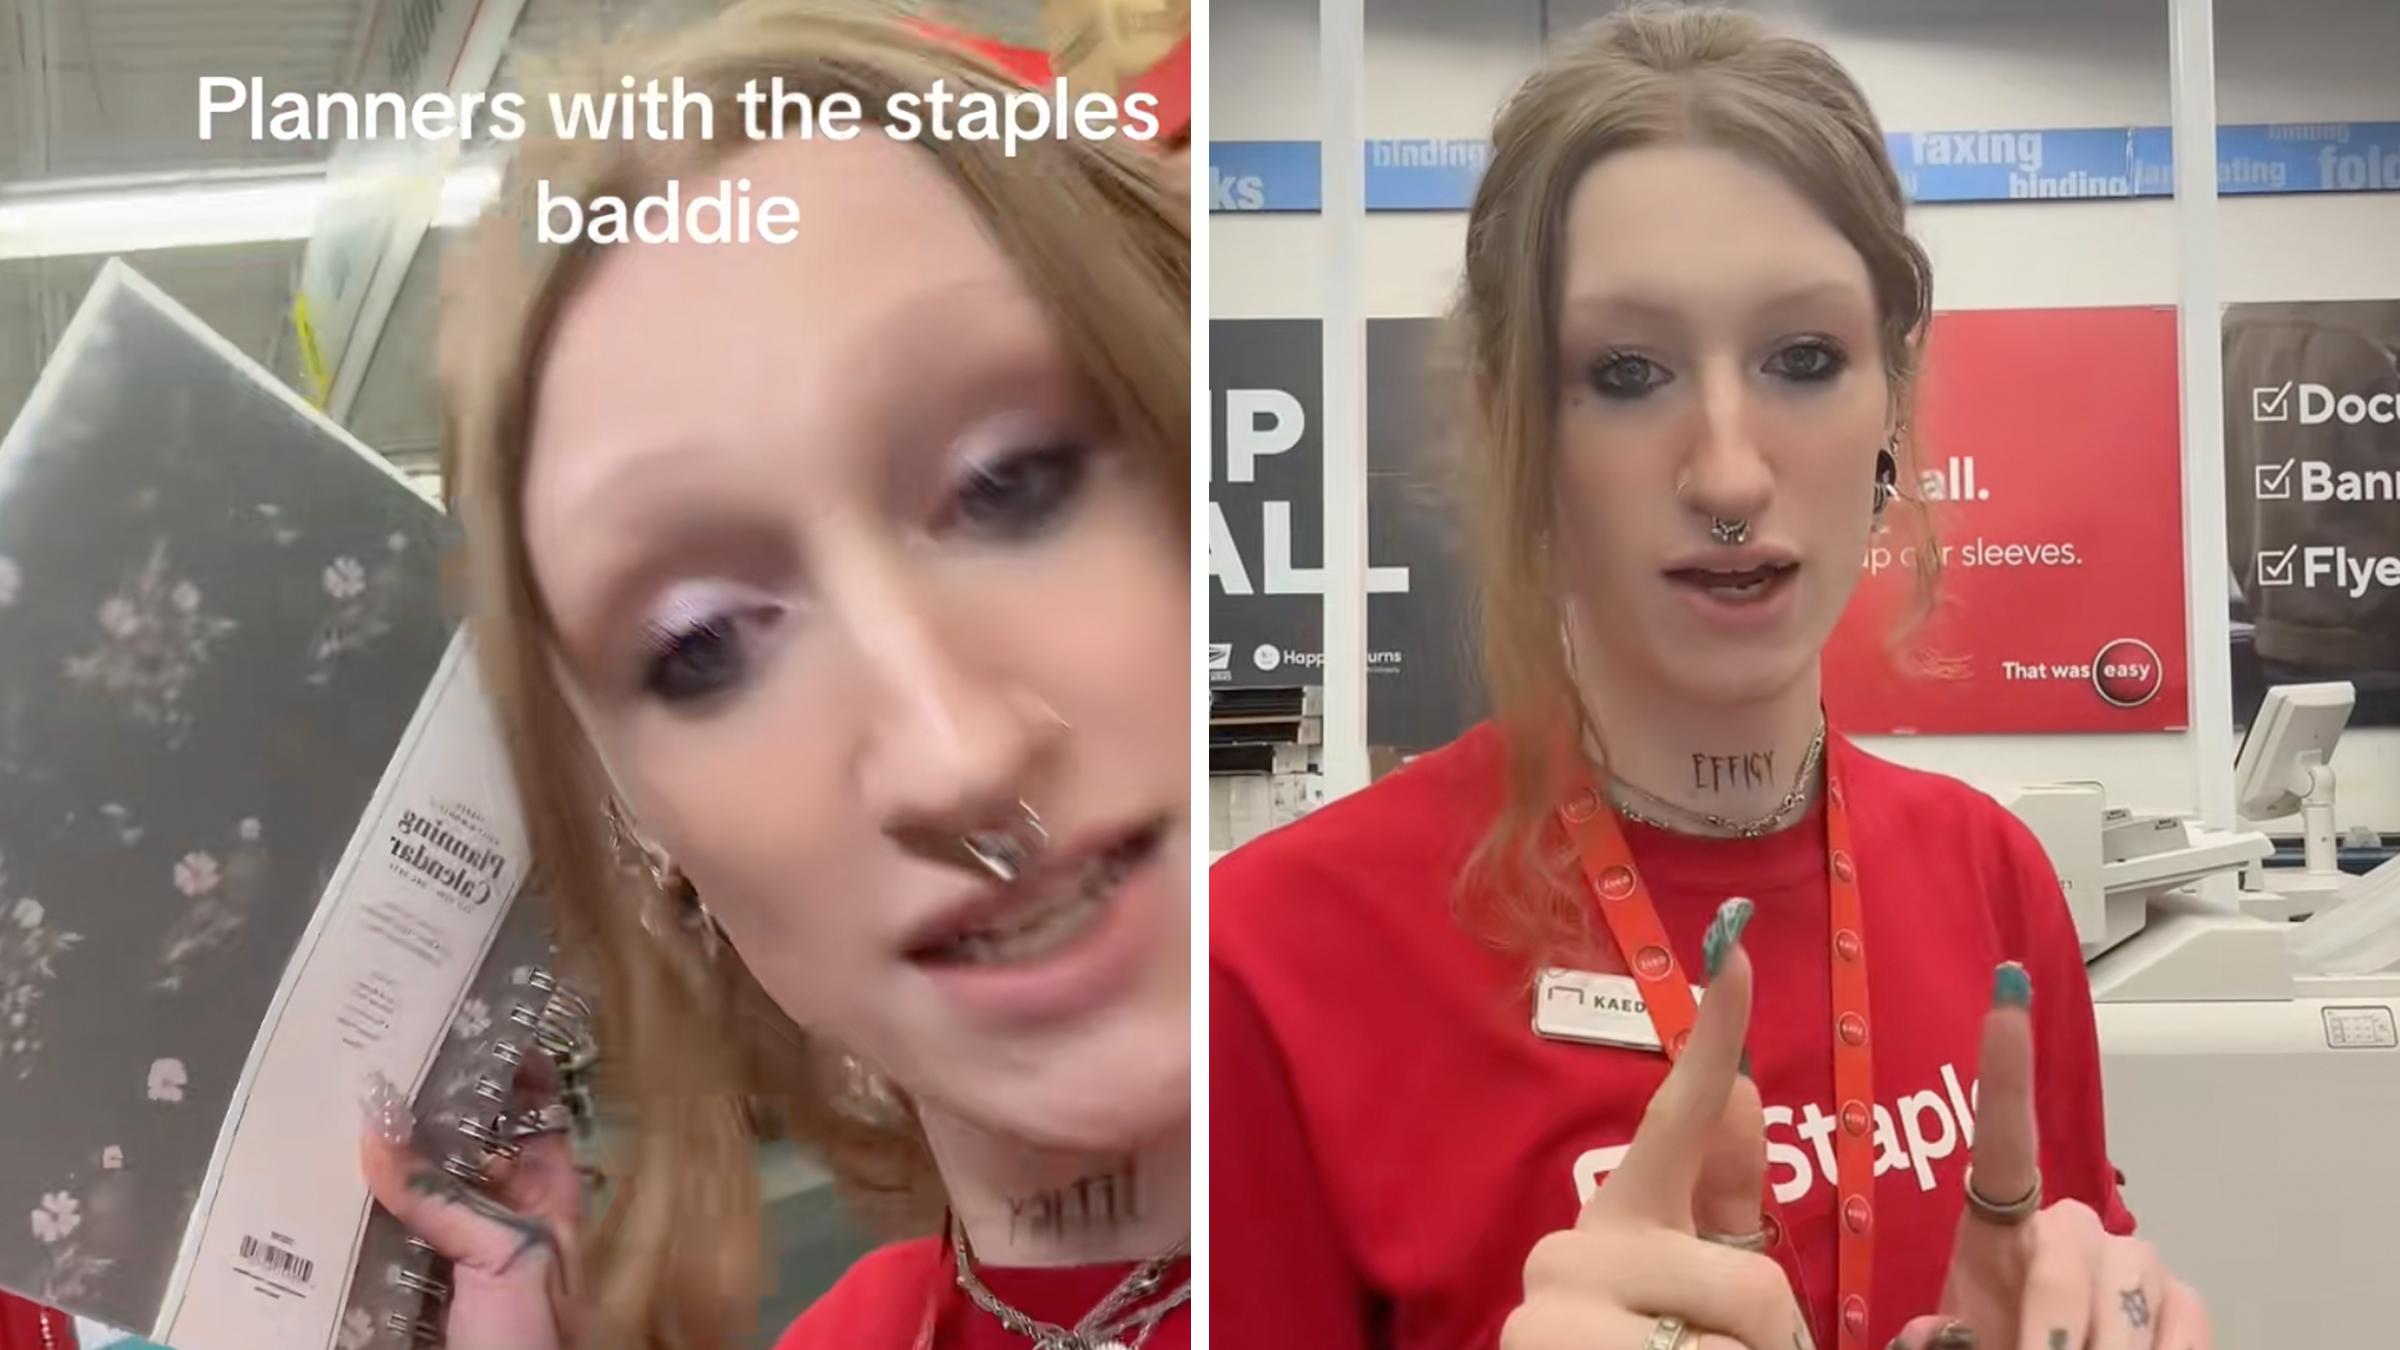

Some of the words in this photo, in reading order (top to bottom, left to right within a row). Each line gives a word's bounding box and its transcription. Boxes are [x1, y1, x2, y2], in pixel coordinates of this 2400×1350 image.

[1209, 166, 1265, 210] ks
[1209, 388, 1305, 482] P
[1920, 456, 1989, 501] all.
[1900, 545, 1953, 567] or
[1961, 537, 2082, 567] sleeves.
[1283, 649, 1325, 669] Happ
[2002, 661, 2047, 680] That
[2051, 664, 2090, 680] was
[2103, 663, 2151, 681] easy
[1691, 750, 1775, 794] EFFIGY
[1762, 1063, 1980, 1205] Stapl
